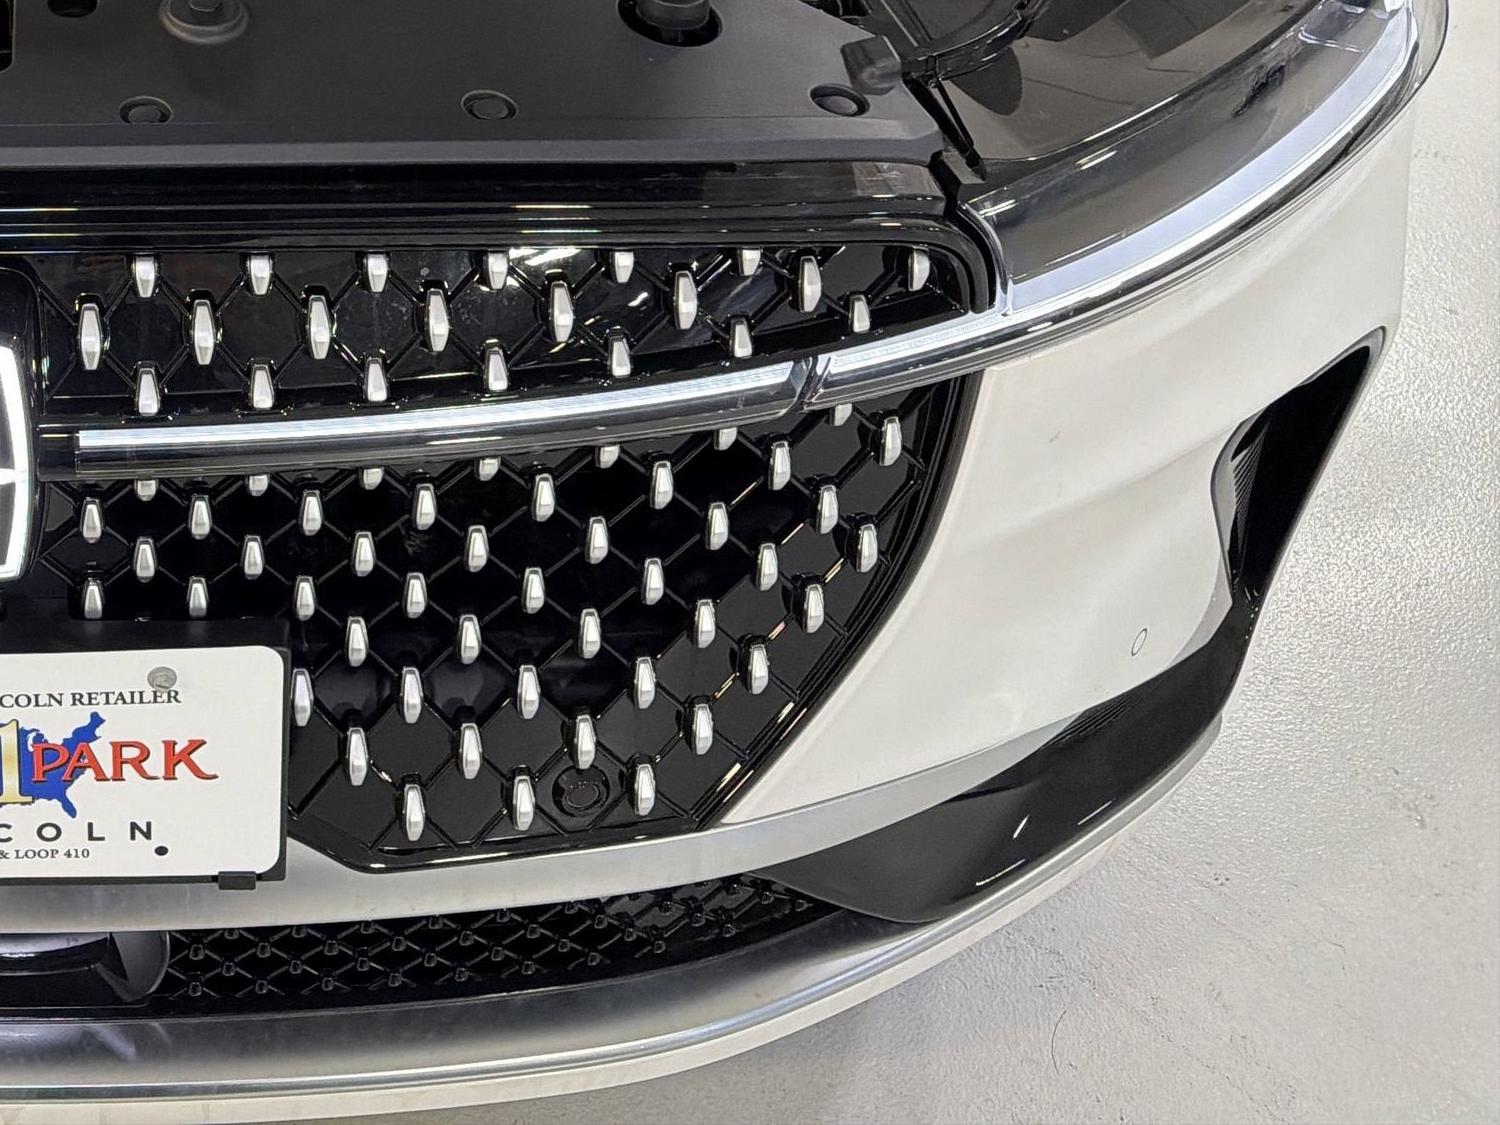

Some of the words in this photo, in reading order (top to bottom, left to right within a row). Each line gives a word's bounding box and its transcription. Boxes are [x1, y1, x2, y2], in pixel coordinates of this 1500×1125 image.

[70, 689, 183, 707] RETAILER
[31, 739, 220, 784] PARK
[14, 848, 60, 860] LOOP
[63, 848, 91, 859] 410
